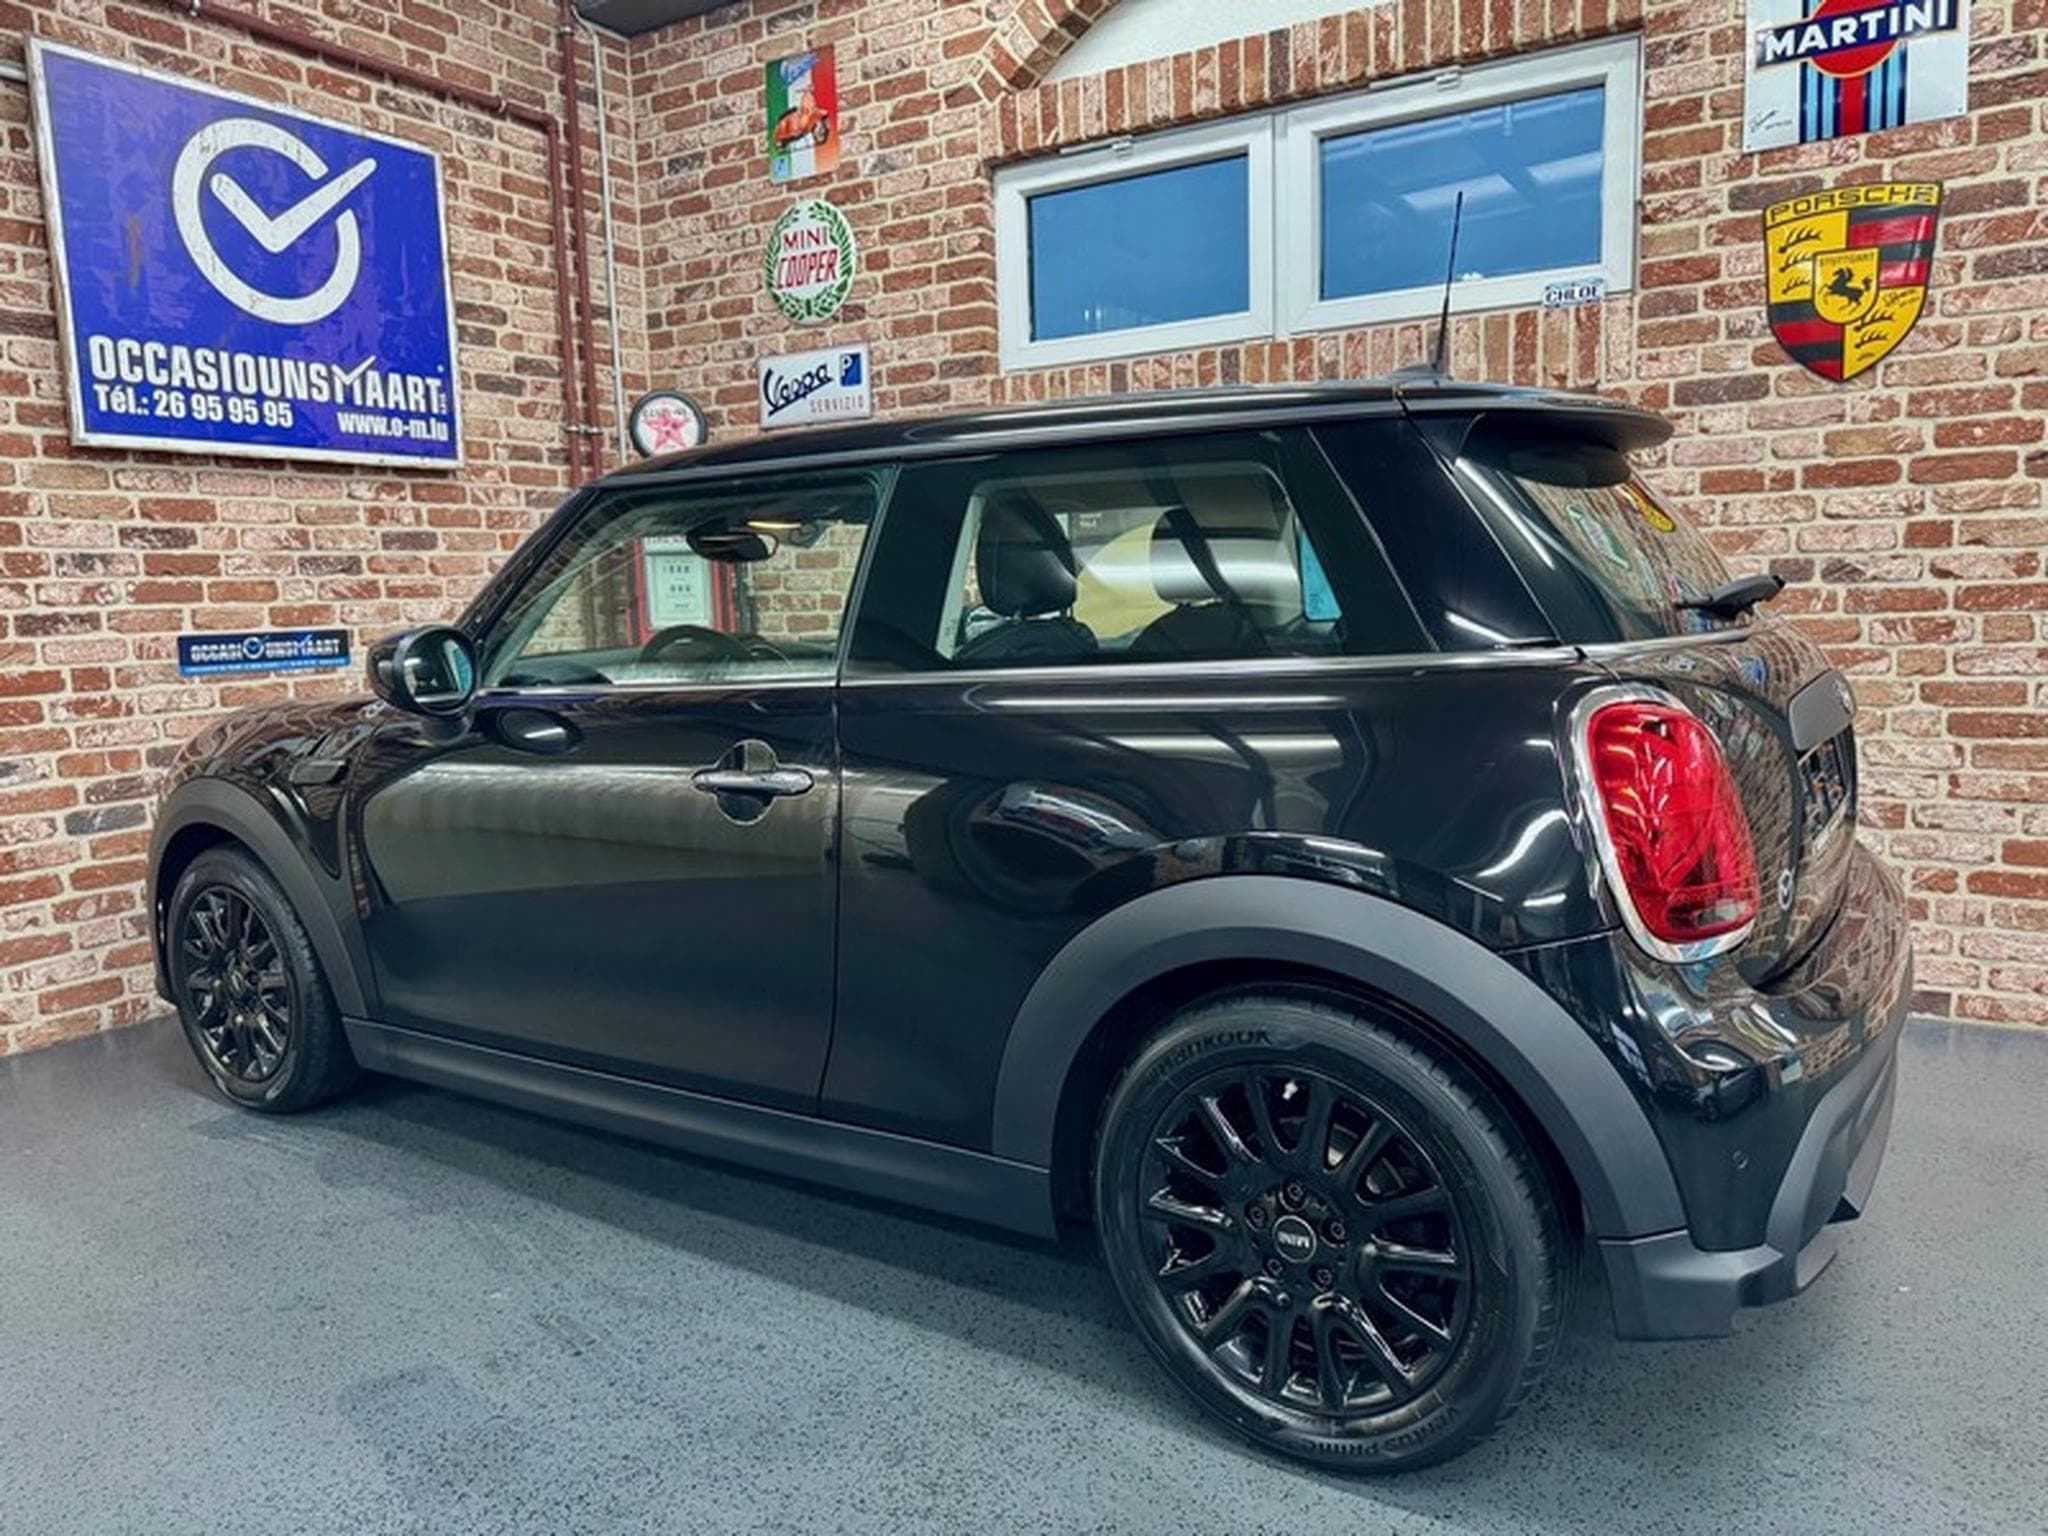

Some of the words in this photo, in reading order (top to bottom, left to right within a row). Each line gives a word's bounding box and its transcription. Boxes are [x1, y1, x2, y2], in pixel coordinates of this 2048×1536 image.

[1764, 0, 1949, 62] MARTINI
[1769, 185, 1936, 223] PORSCHE
[783, 225, 828, 252] MINI
[776, 248, 838, 290] COOPER
[93, 383, 150, 416] Tél.:
[152, 390, 186, 419] 26
[191, 393, 224, 423] 95
[227, 396, 260, 426] 95
[263, 401, 294, 429] 95
[763, 364, 834, 417] Vespa
[809, 394, 865, 414] SERVIZIO
[336, 411, 449, 442] www.o-m.lu
